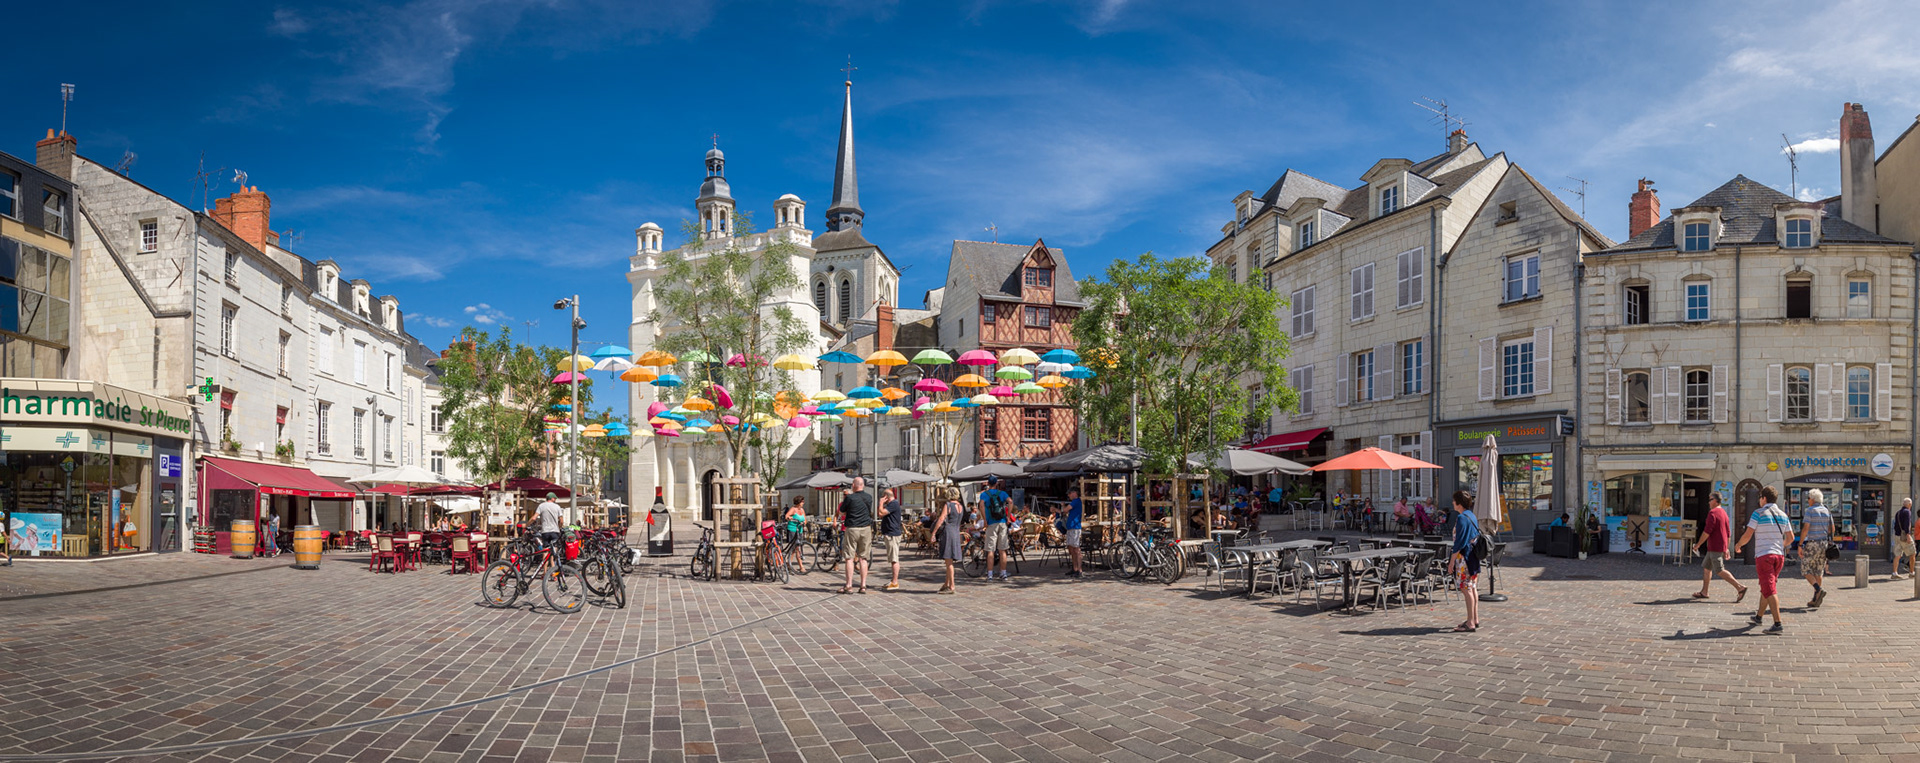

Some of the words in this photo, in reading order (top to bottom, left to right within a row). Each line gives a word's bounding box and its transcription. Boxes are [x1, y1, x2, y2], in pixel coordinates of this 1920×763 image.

[139, 405, 152, 426] St
[156, 409, 191, 434] Pierre
[1507, 424, 1546, 437] Pâtisserie
[1784, 455, 1867, 469] guy.hoquet.com
